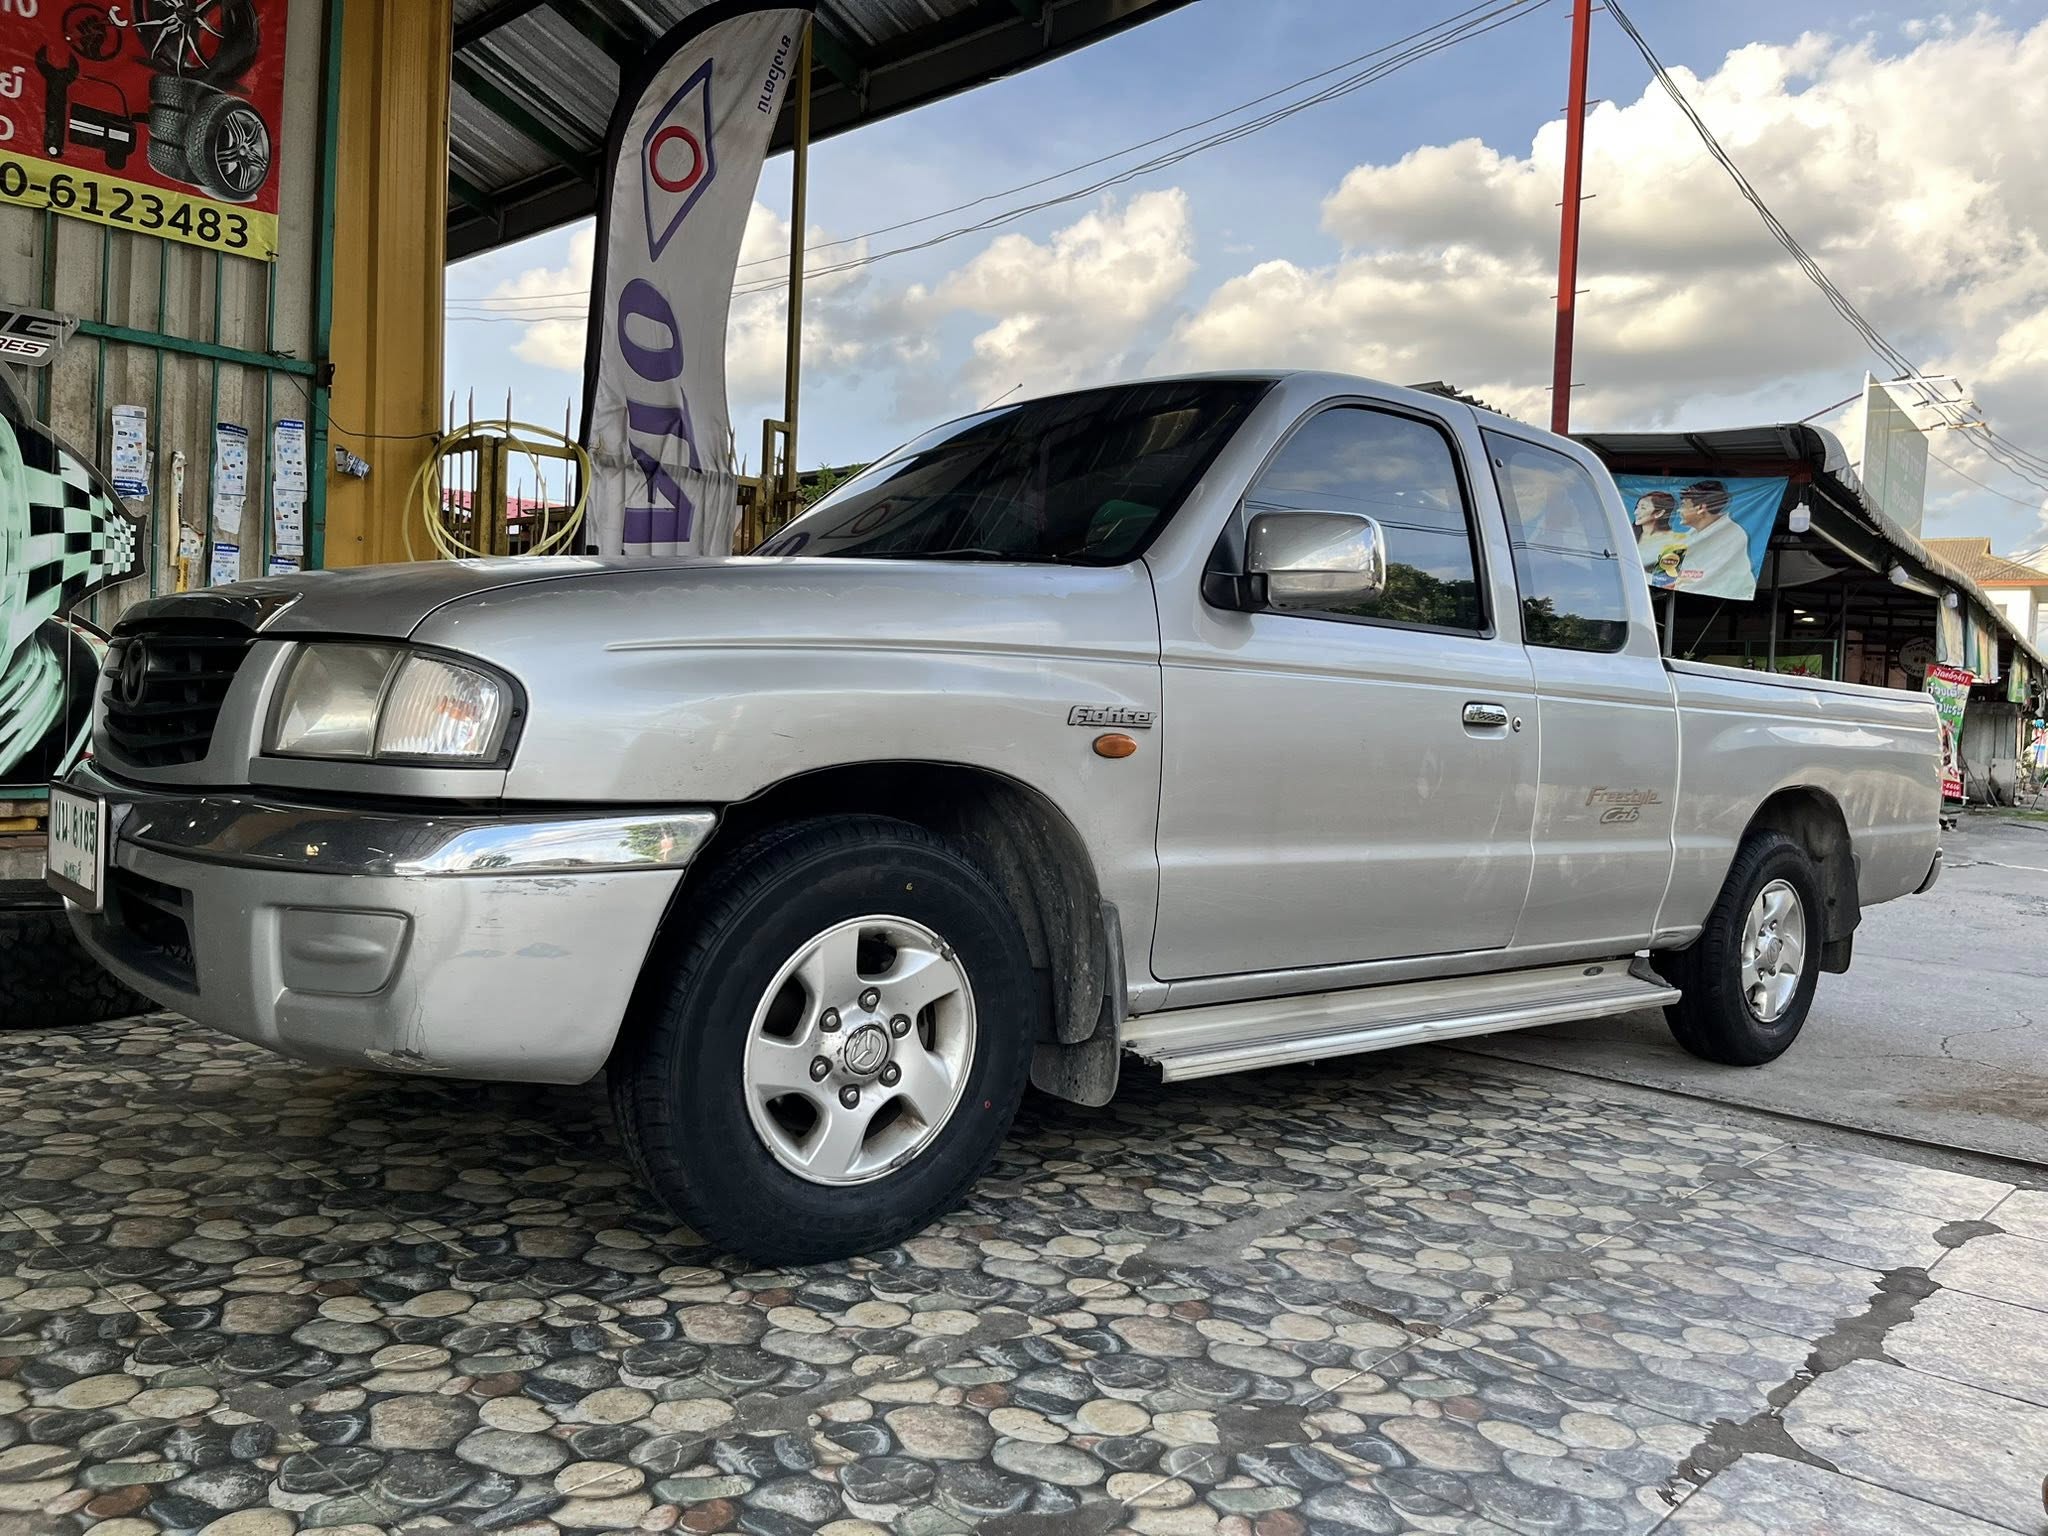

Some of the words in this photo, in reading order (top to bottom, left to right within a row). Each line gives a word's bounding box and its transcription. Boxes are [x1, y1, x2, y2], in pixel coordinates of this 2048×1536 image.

[1068, 705, 1158, 729] Fighter
[1585, 784, 1663, 807] Freestyle
[1599, 804, 1640, 825] Cab
